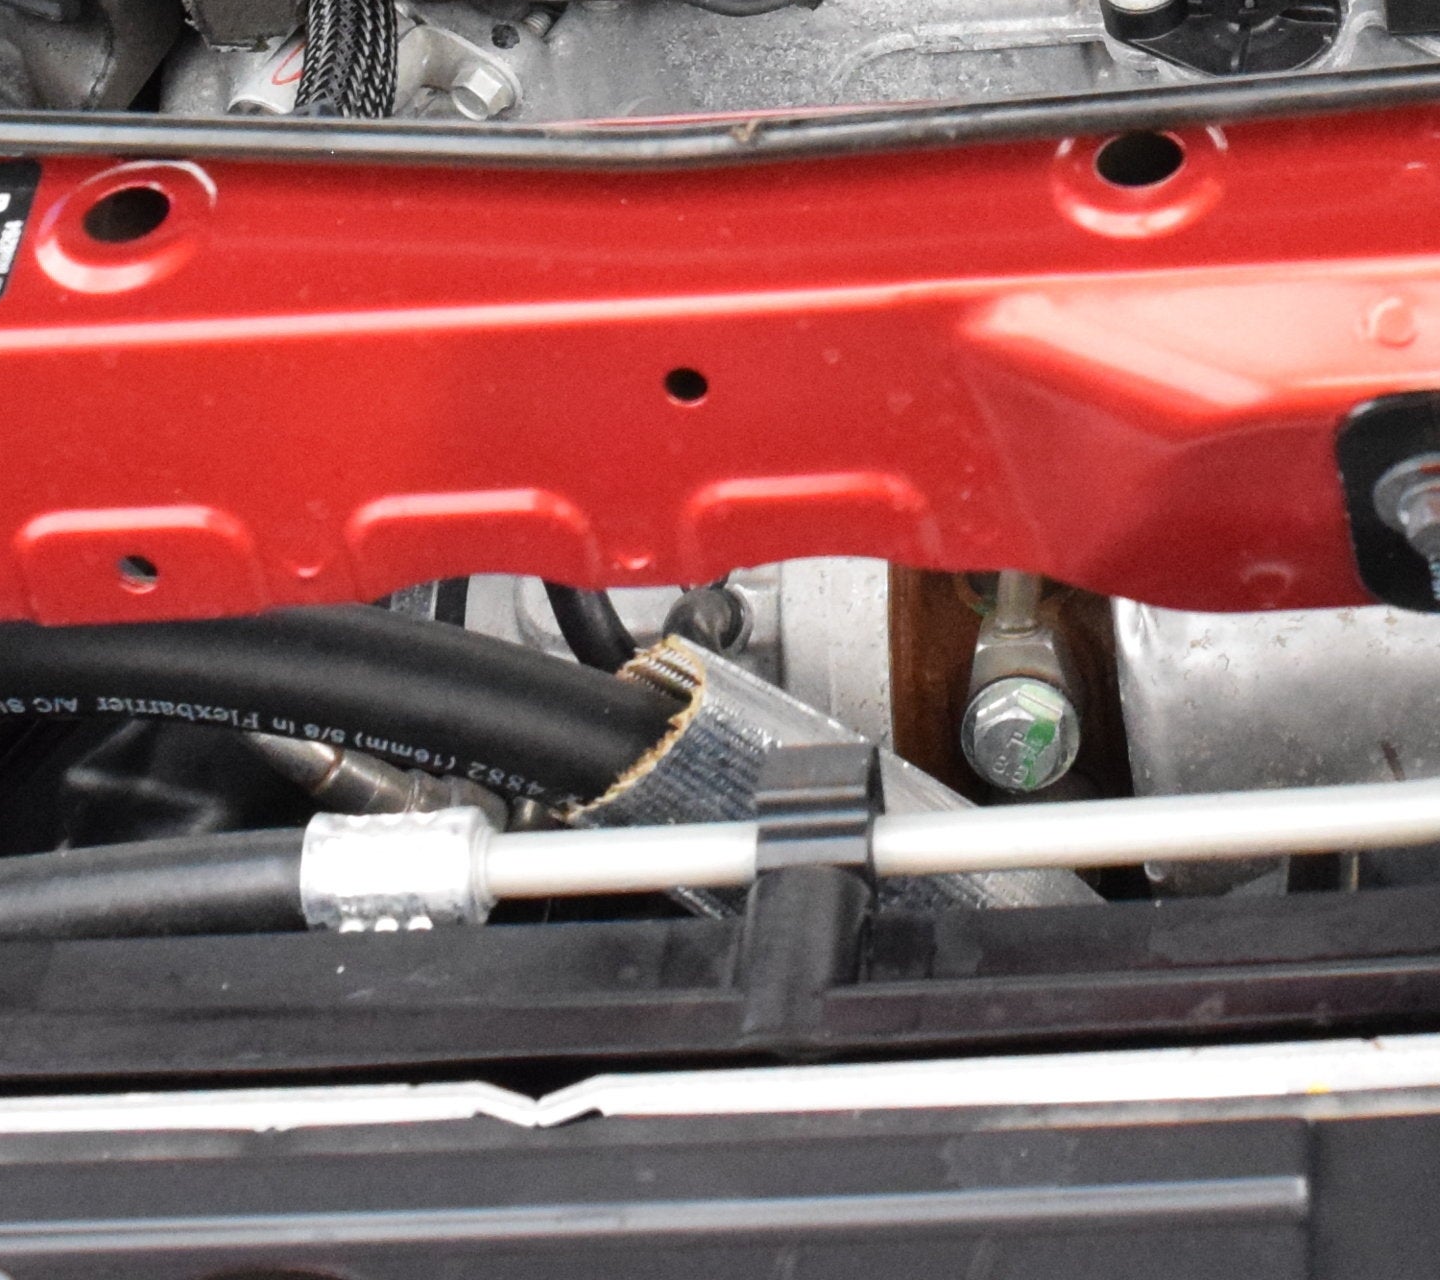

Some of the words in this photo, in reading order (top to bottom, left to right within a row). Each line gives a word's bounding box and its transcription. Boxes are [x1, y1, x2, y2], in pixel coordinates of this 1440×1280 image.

[31, 695, 79, 712] A/C
[94, 695, 258, 729] Flexbarrier
[271, 715, 294, 734] in
[302, 722, 345, 743] 5/8
[354, 730, 455, 769] (16mm)
